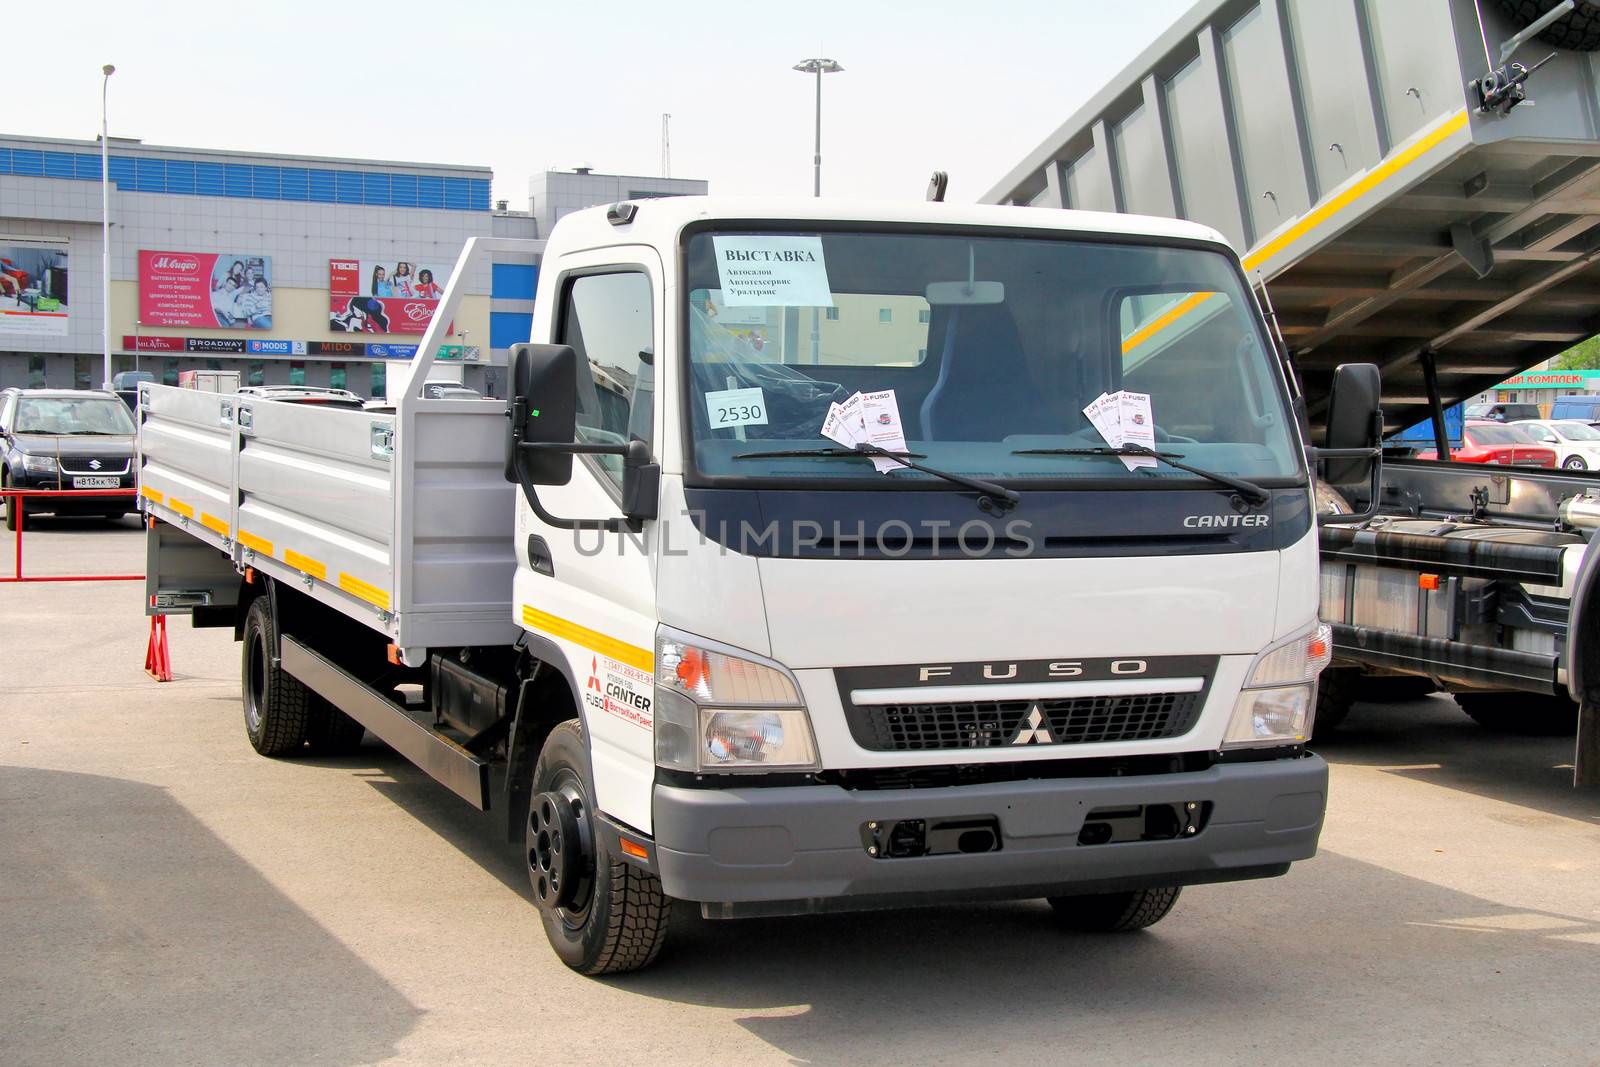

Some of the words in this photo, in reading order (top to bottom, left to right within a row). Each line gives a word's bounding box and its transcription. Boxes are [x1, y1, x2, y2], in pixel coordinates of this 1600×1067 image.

[725, 249, 816, 262] ВЫСТАВКА
[727, 268, 772, 276] Автосалон
[728, 278, 791, 287] Автотехсервис
[730, 288, 777, 296] Уралтранс
[190, 339, 242, 347] BROADWAY
[262, 342, 288, 350] MODIS
[321, 343, 352, 351] MIDO
[843, 396, 860, 411] FUSO
[718, 405, 762, 423] 2530
[1183, 514, 1270, 528] CANTER
[919, 659, 1149, 682] FUSO
[586, 692, 604, 710] FUSO
[606, 682, 652, 712] CANTER
